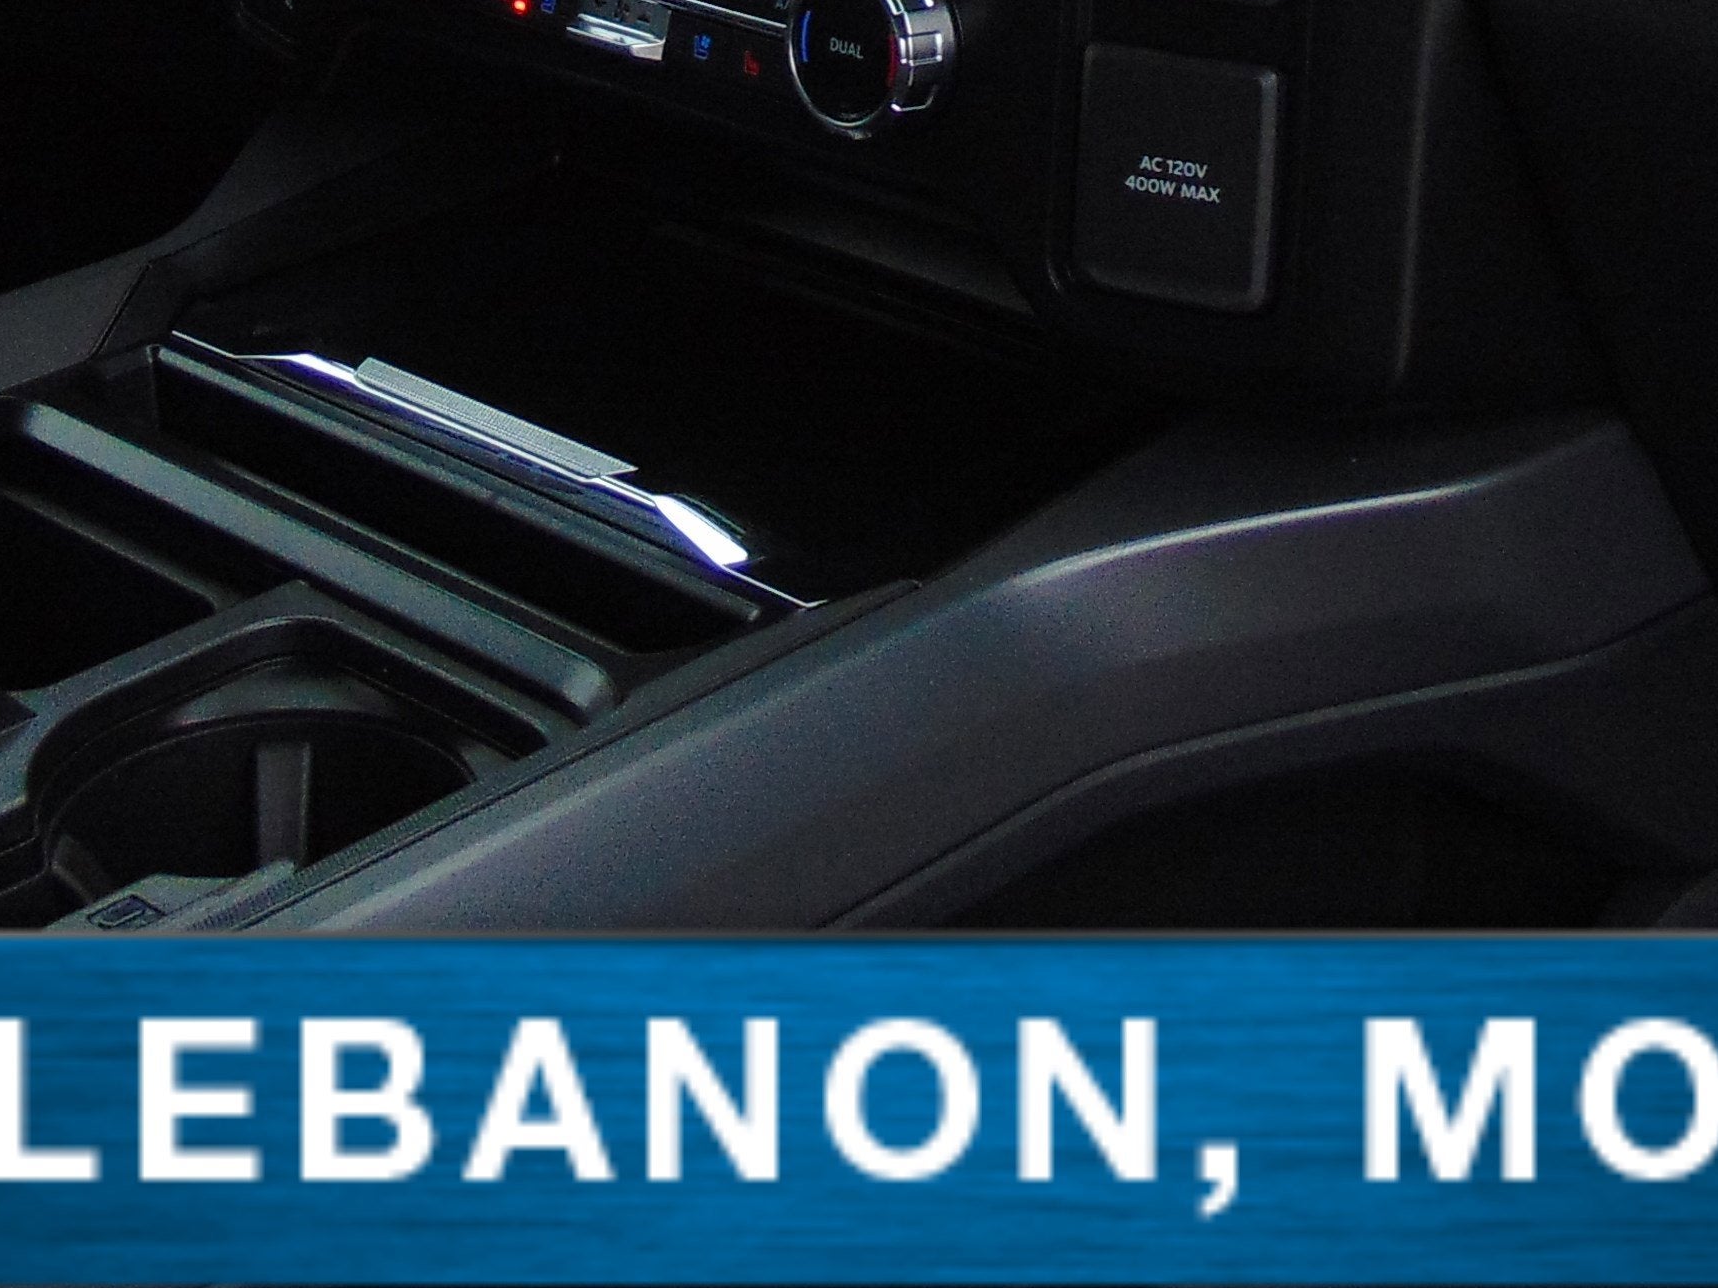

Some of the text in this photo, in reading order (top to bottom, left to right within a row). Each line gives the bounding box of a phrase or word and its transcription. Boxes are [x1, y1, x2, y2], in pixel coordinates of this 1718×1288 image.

[828, 36, 865, 60] DUAL
[1139, 154, 1209, 181] AC 120V
[1124, 174, 1222, 205] 400W MAX
